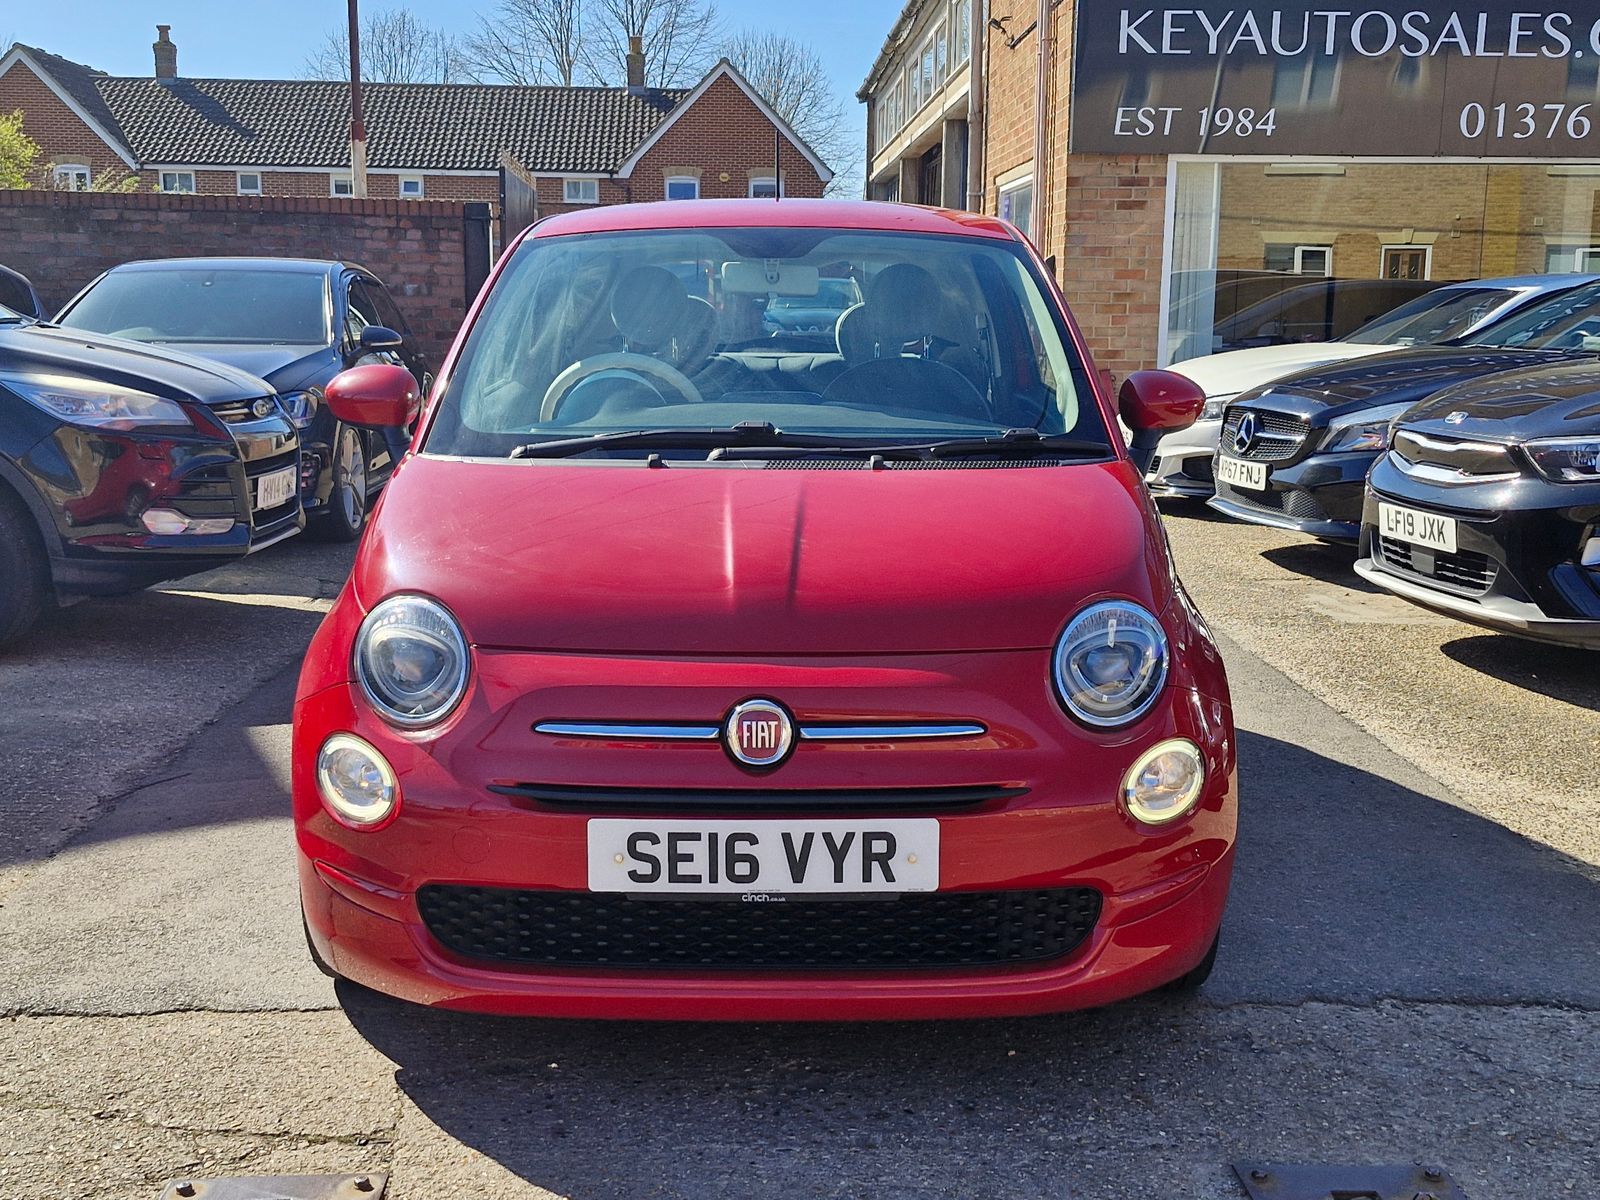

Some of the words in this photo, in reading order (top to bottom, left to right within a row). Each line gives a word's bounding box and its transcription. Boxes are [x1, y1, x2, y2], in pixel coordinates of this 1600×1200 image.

[1117, 9, 1600, 58] KEYAUTOSALES.
[1113, 106, 1182, 137] EST
[1198, 106, 1277, 138] 1984
[1459, 102, 1592, 139] 01376
[1239, 464, 1261, 485] FNJ
[1386, 508, 1415, 536] LF19
[1419, 516, 1446, 544] JXK
[742, 720, 779, 749] FIAT
[626, 832, 760, 884] SE16
[781, 831, 897, 883] VYR
